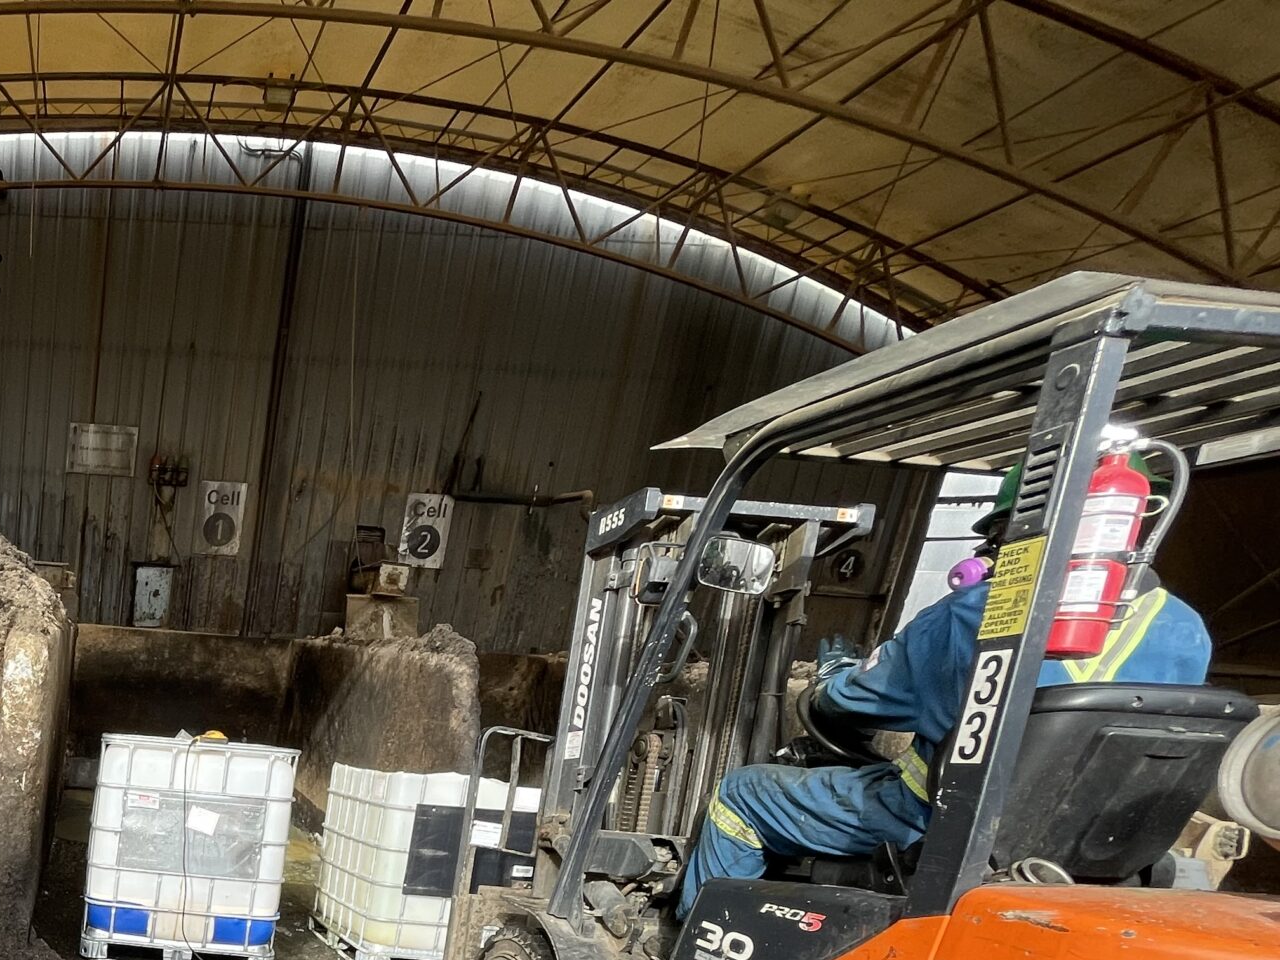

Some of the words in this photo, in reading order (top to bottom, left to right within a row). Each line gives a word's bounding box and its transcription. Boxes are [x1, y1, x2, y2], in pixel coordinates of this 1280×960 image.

[207, 489, 240, 506] Cell
[414, 500, 448, 518] Cell
[215, 519, 224, 541] 1
[417, 531, 432, 553] 2
[840, 556, 855, 578] 4
[999, 557, 1021, 569] AND
[1008, 575, 1033, 586] USING
[984, 617, 1019, 628] OPERATE
[987, 609, 1024, 621] ALLOWED
[573, 597, 603, 729] DOOSAN
